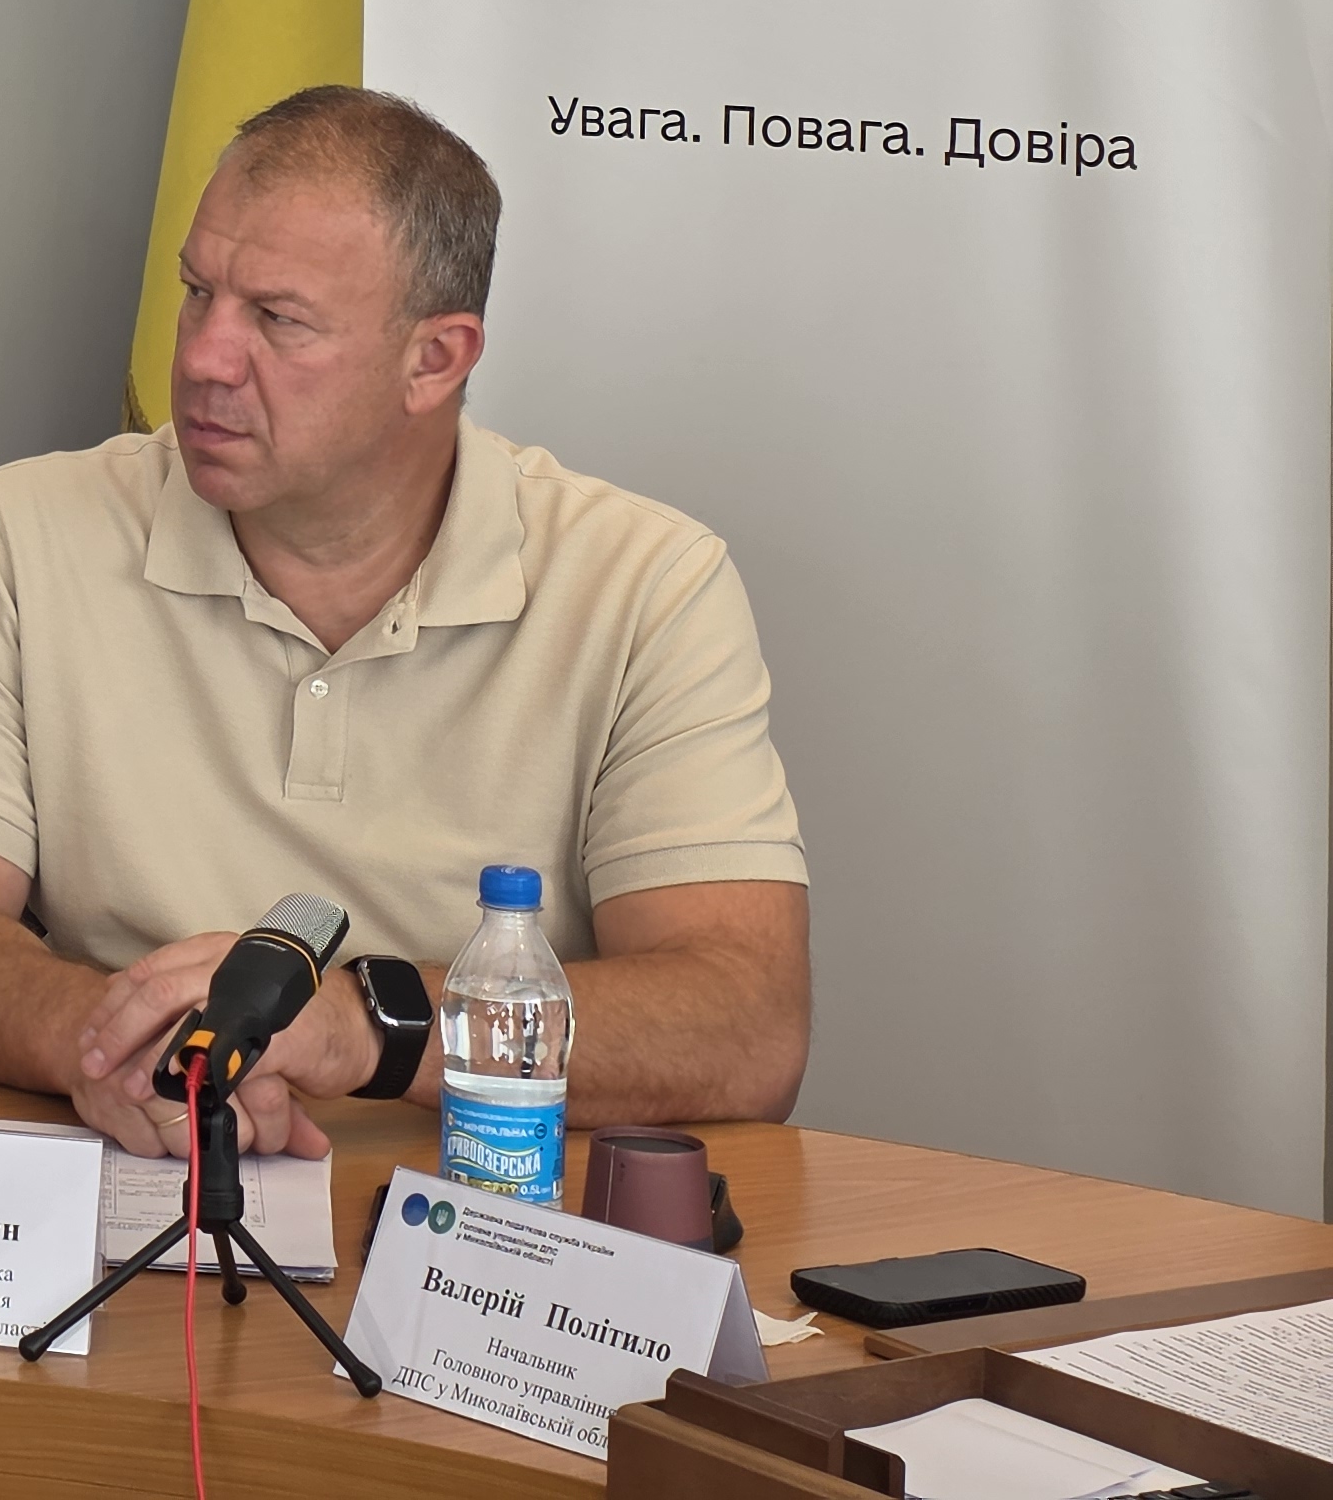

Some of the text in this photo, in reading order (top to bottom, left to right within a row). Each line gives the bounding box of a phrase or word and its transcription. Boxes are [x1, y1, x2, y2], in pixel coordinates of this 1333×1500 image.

[547, 96, 1137, 176] Увага. Повага. Довіра
[421, 1266, 671, 1363] Валерій Політило
[432, 1349, 518, 1391] Головного
[487, 1338, 577, 1381] Начальник
[392, 1367, 434, 1392] ДПС
[437, 1382, 448, 1399] у
[451, 1383, 574, 1438] Миколаївській
